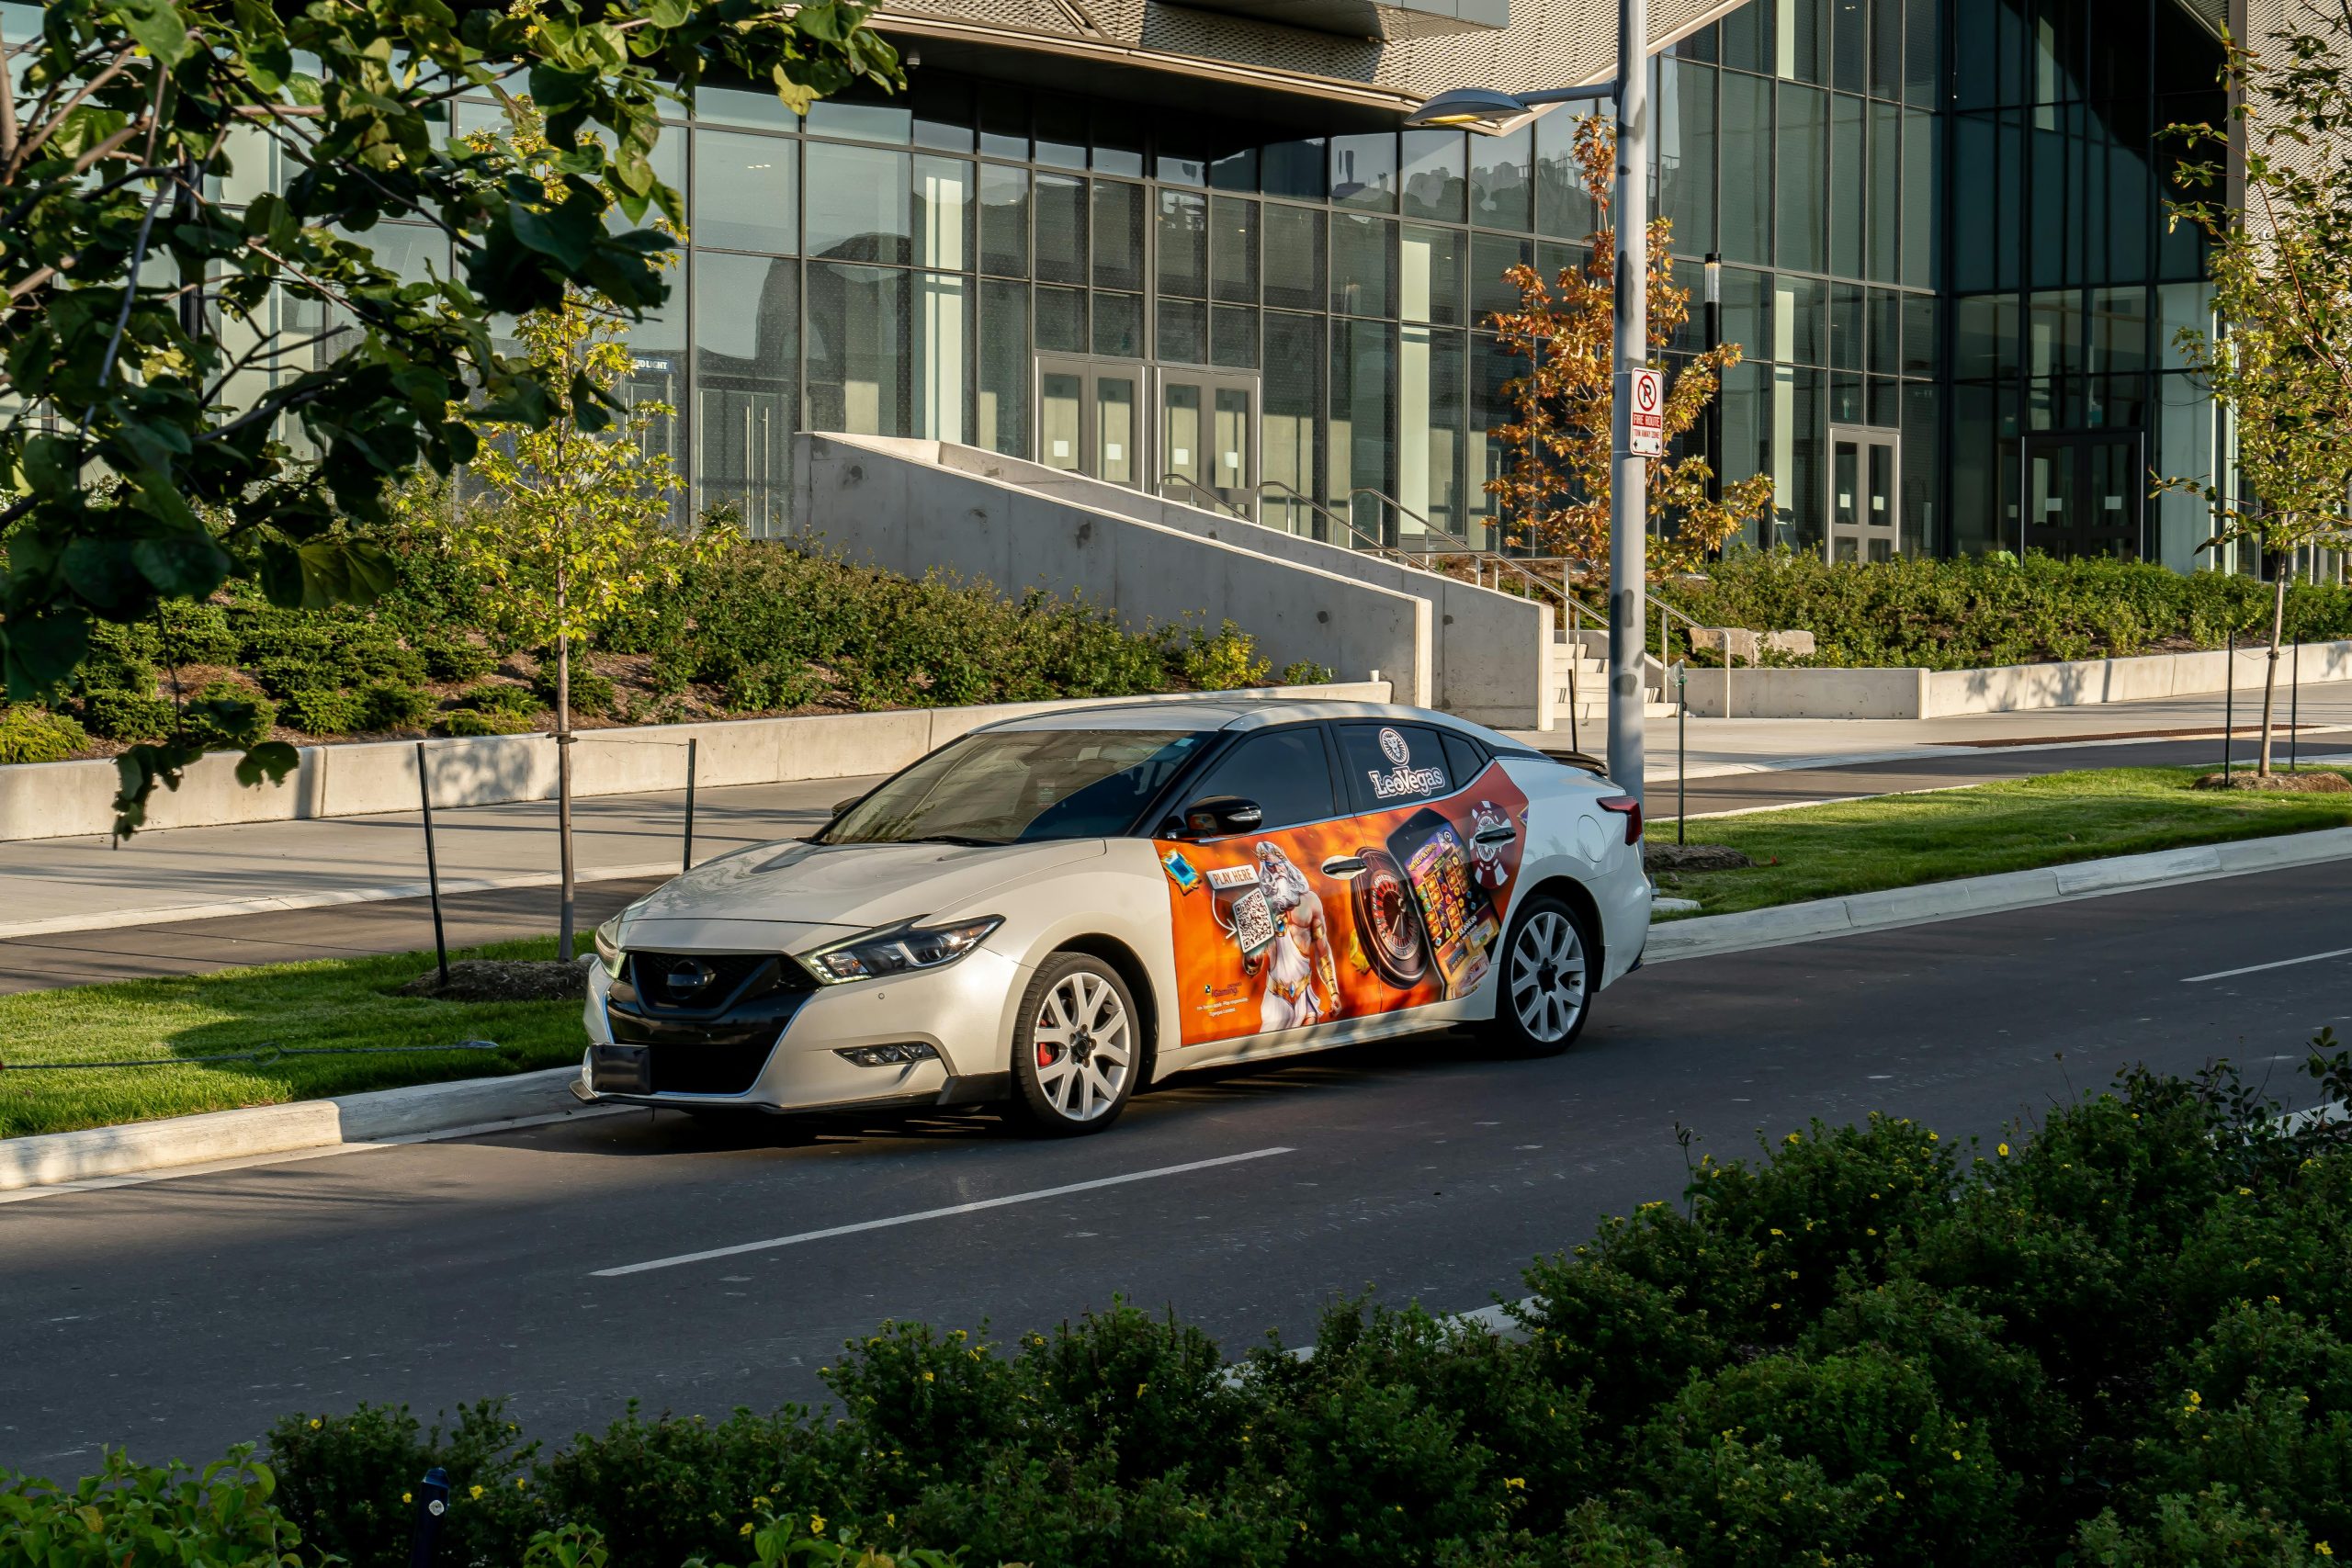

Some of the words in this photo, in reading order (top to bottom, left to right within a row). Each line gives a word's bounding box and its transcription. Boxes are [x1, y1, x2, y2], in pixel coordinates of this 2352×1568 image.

[646, 360, 668, 369] LIGHT
[1633, 413, 1644, 425] FIRE
[1645, 415, 1659, 427] ROUTE
[1369, 767, 1444, 797] LeoVegas
[1213, 873, 1232, 886] PLAY
[1232, 869, 1253, 882] HERE
